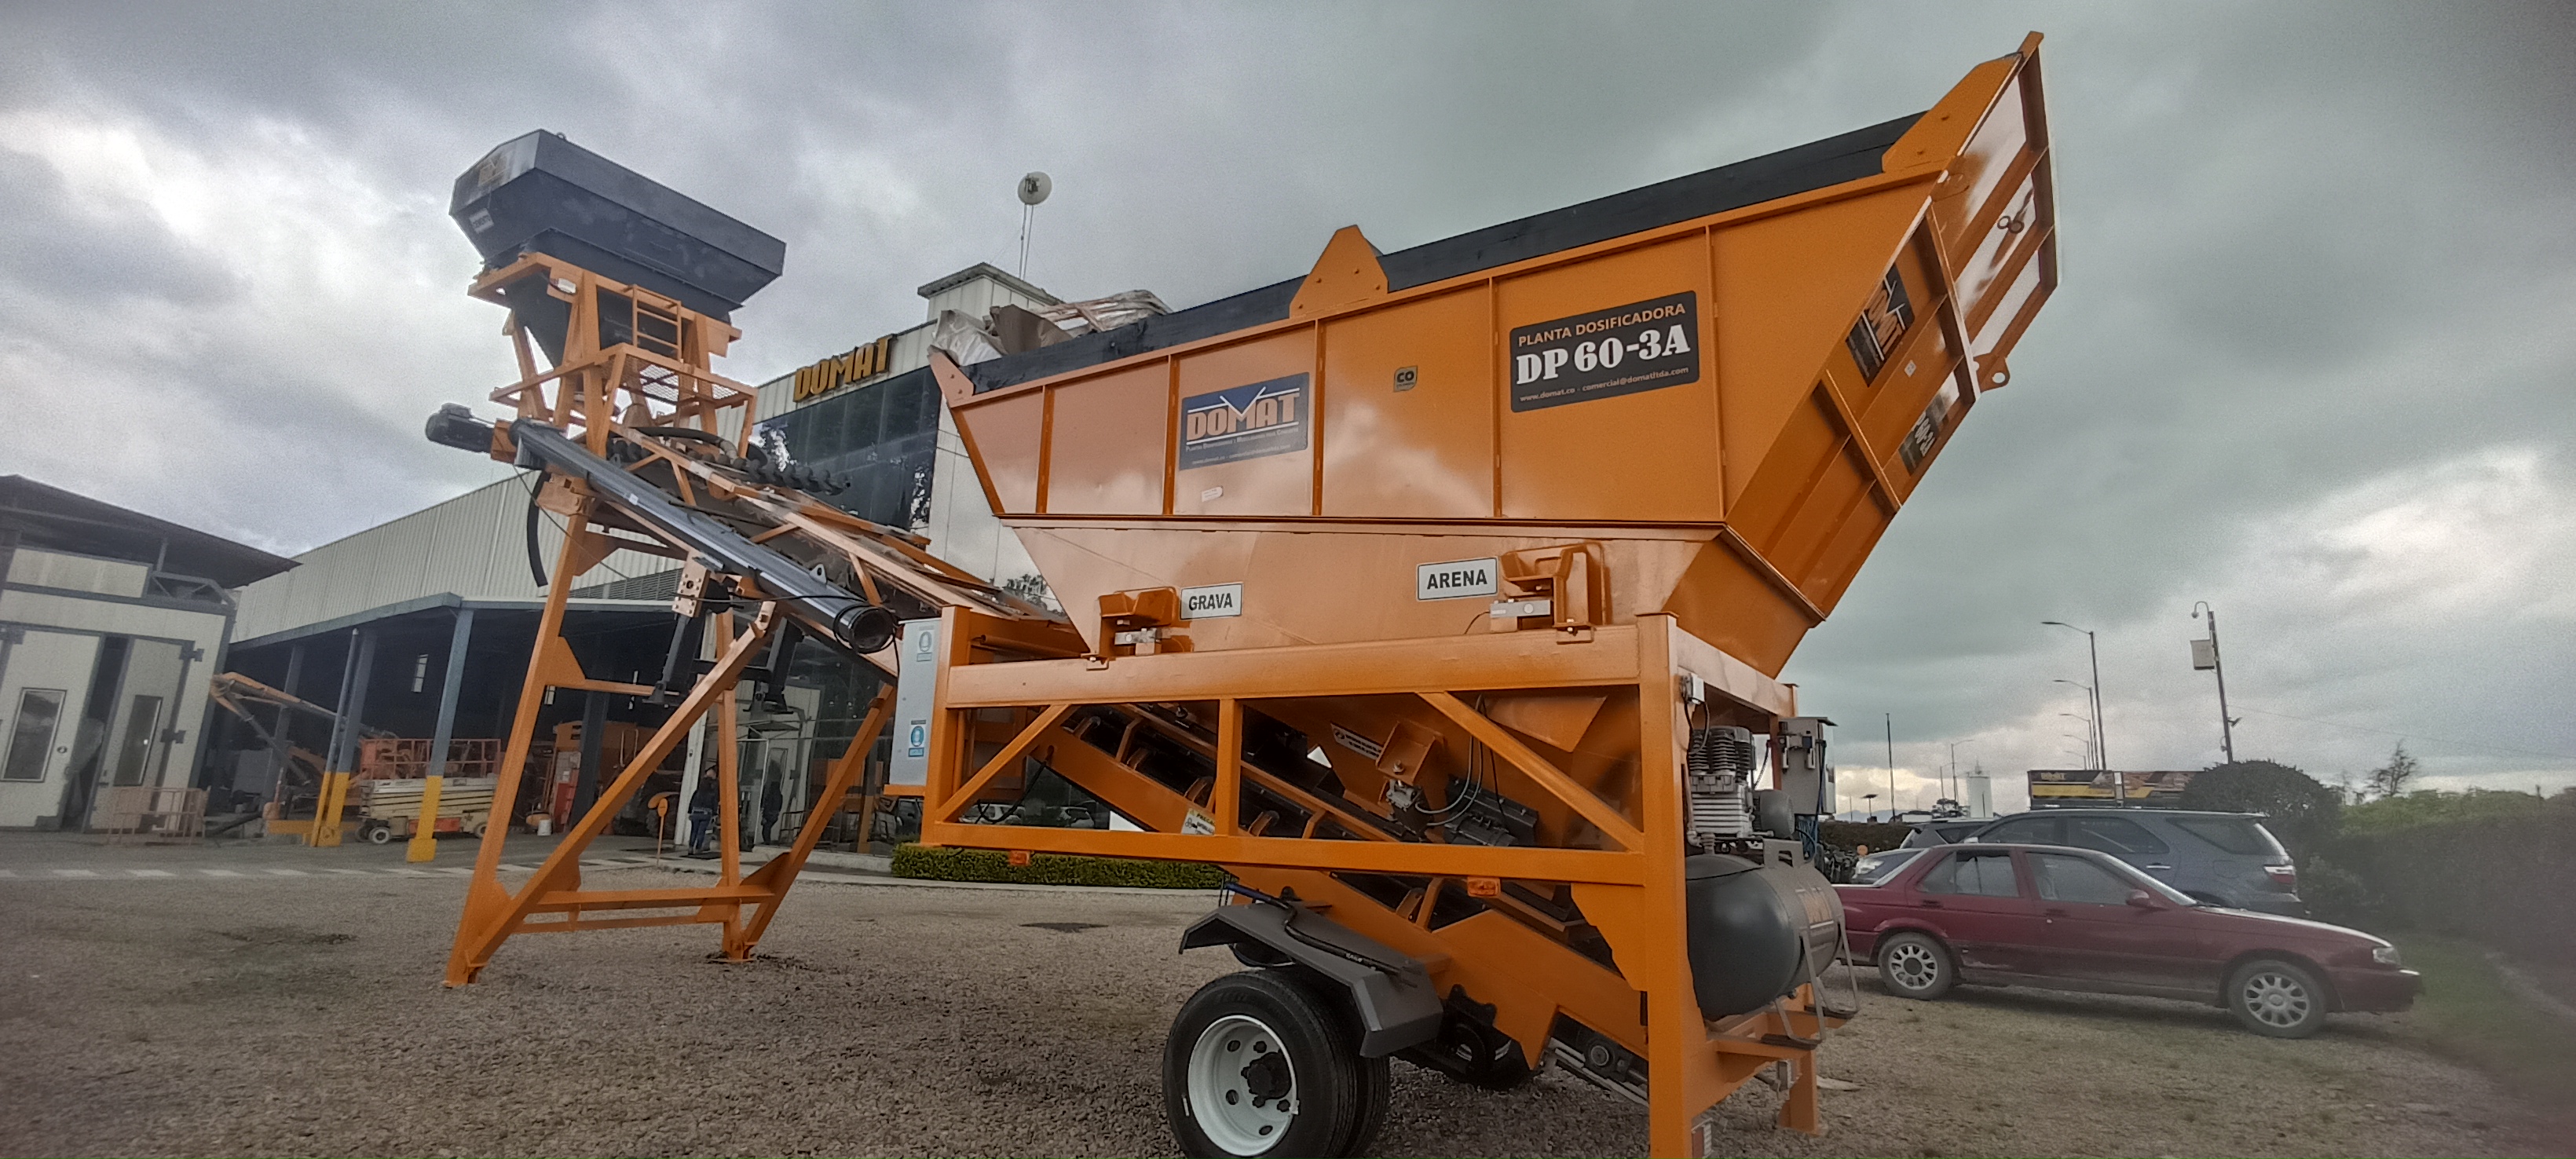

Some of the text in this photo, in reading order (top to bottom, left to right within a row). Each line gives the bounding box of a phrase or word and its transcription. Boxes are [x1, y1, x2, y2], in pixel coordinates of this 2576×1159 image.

[1518, 303, 1686, 347] PLANTA DOSIFICADORA
[793, 336, 893, 402] DOMAT
[1517, 324, 1691, 384] DP 60-3A
[1396, 371, 1414, 382] CO
[1520, 388, 1575, 401] www.domat.co
[1582, 367, 1689, 392] comercial@domatltda.com
[1187, 391, 1300, 441] DOMAT
[1427, 569, 1487, 590] ARENA
[1188, 593, 1232, 610] GRAVA
